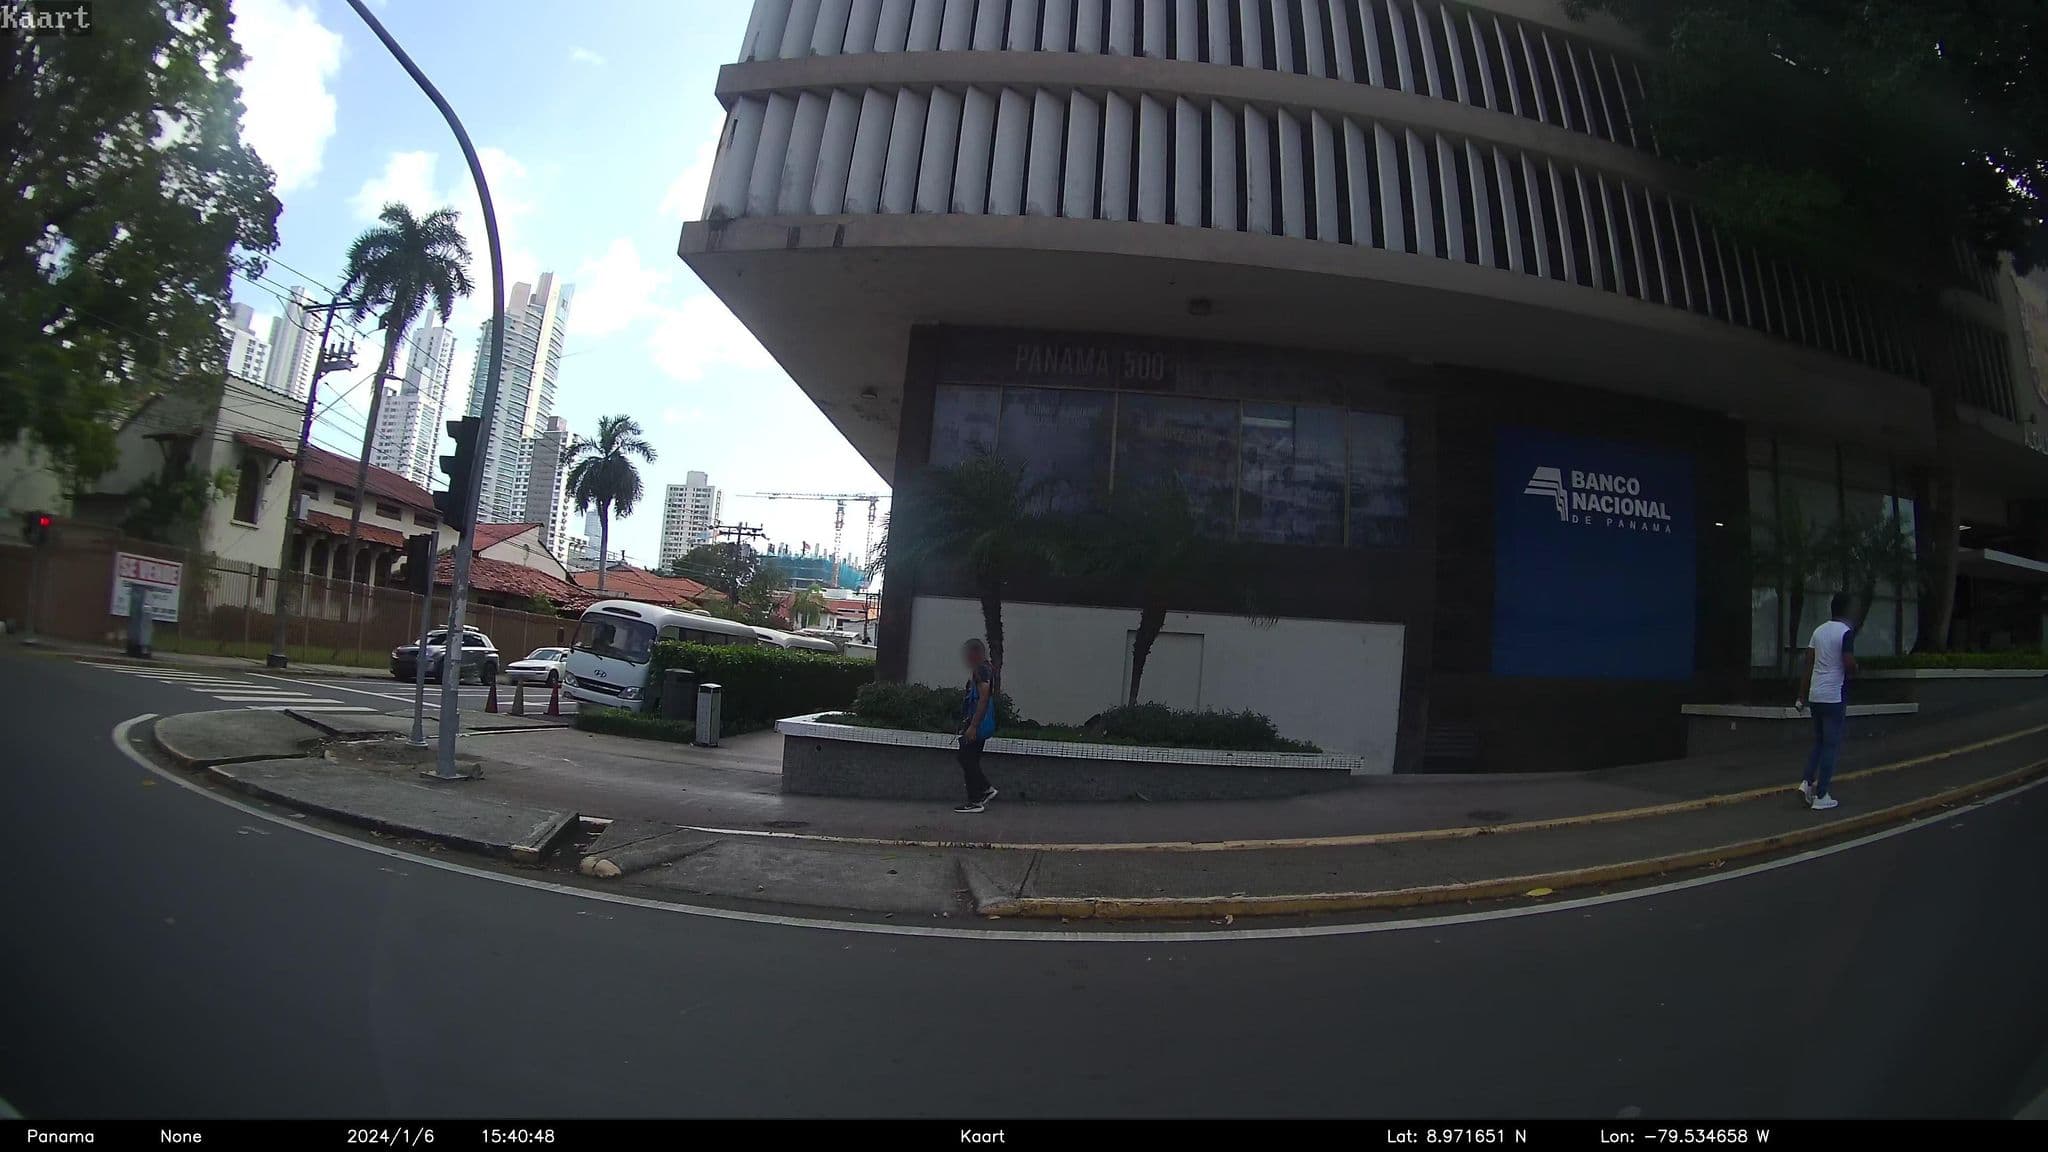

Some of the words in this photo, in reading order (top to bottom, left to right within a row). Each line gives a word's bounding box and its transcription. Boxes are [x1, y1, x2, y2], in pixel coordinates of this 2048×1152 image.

[1015, 343, 1109, 376] PANAMA
[1124, 350, 1166, 381] 500
[1571, 470, 1640, 496] BANCO
[1572, 491, 1672, 520] NACIONAL
[1572, 514, 1592, 525] DE
[1606, 517, 1672, 534] PANAMA
[119, 557, 136, 578] SE
